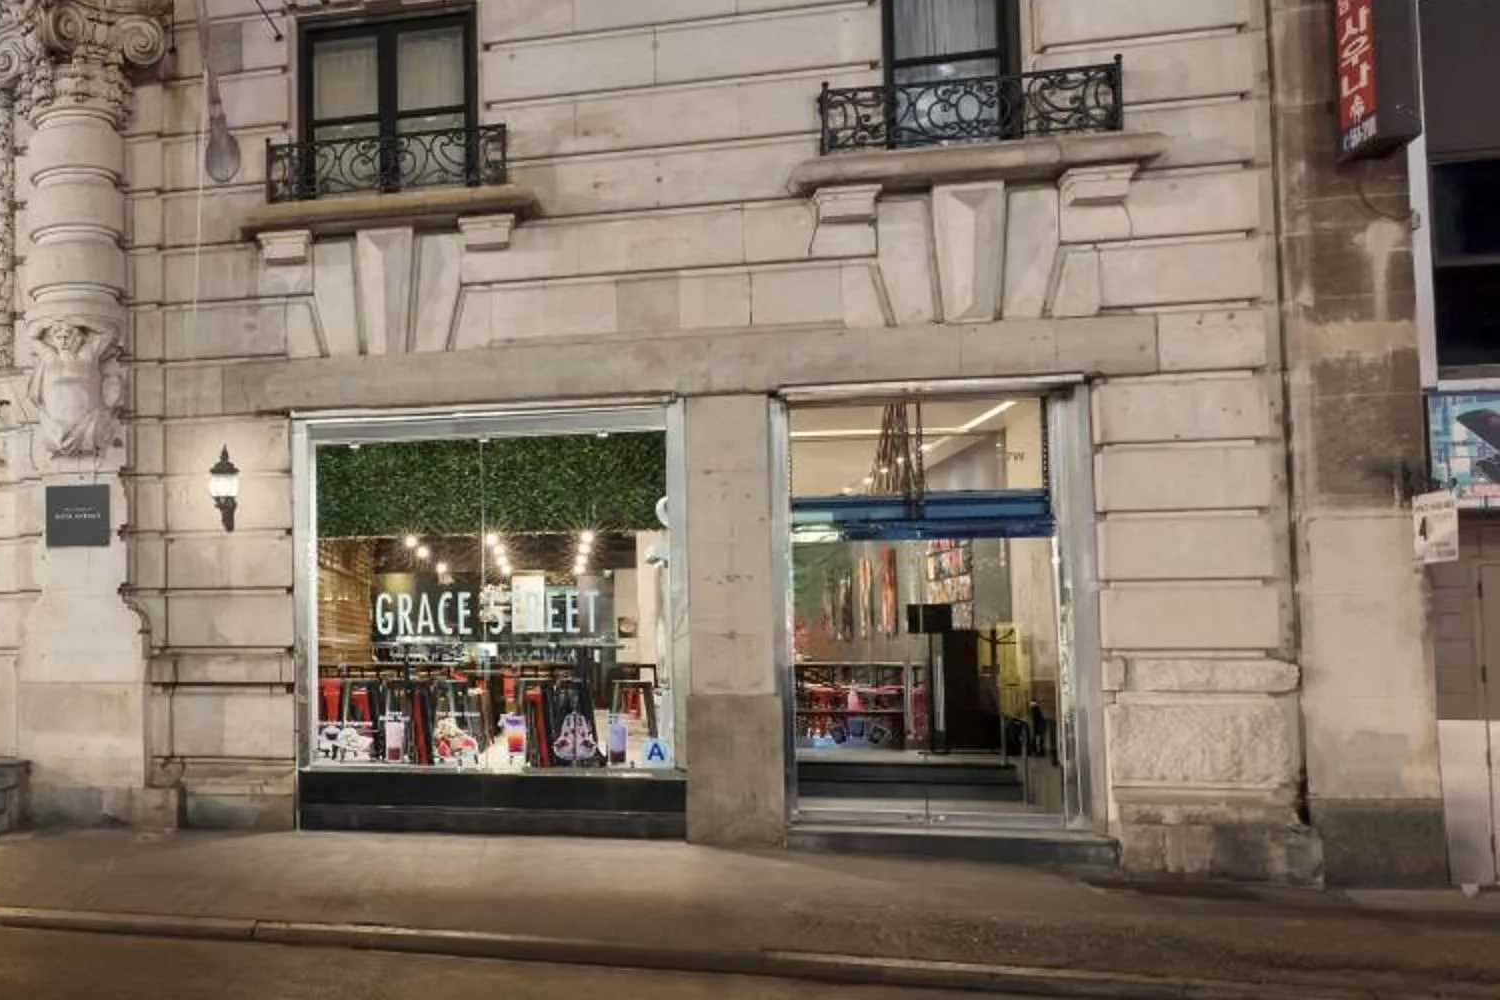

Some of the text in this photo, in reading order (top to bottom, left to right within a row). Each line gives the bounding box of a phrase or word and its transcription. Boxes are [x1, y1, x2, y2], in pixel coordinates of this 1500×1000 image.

[375, 590, 600, 636] GRACE SREET
[647, 743, 665, 761] A
